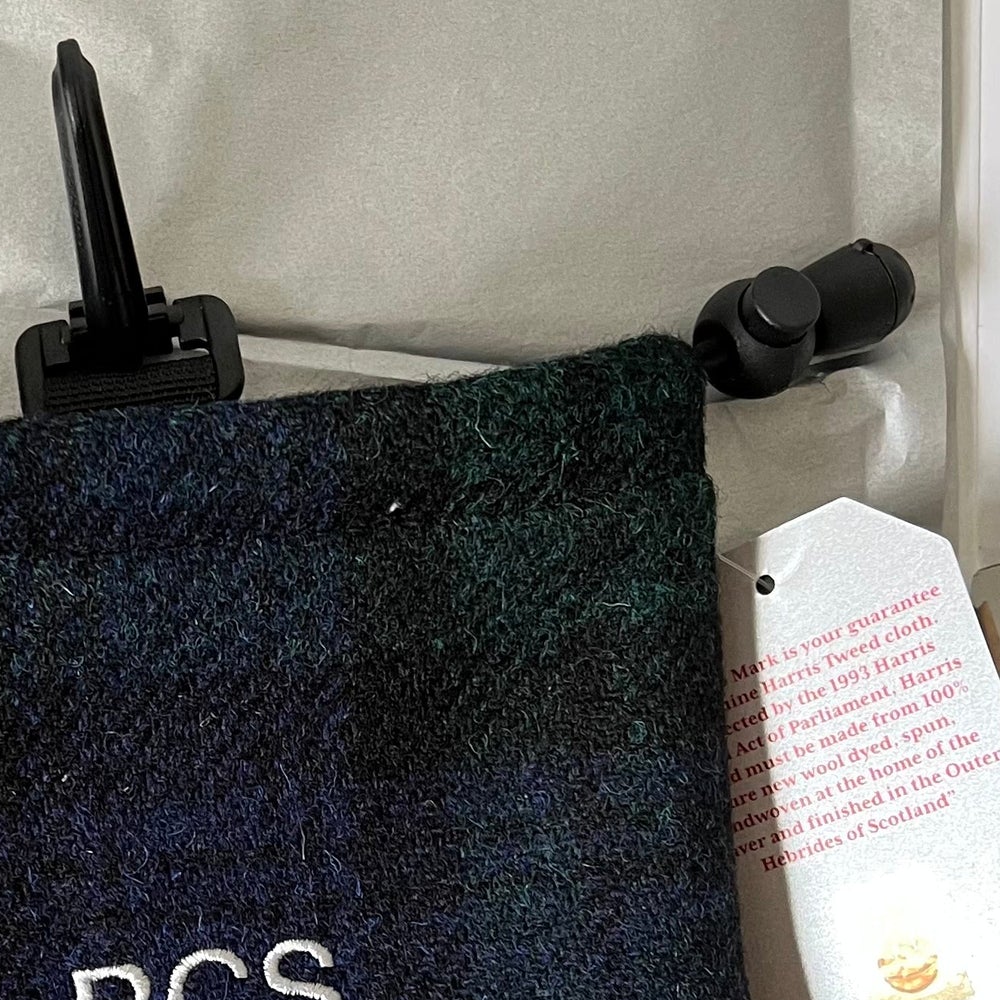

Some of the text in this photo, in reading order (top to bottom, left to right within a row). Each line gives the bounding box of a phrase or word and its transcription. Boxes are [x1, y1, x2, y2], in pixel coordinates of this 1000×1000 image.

[730, 584, 942, 683] Mark is your guarantee
[761, 662, 821, 695] Harris
[823, 636, 881, 668] Tweed
[884, 614, 939, 645] cloth.
[736, 655, 963, 757] Act of Parliament, Harris
[772, 699, 793, 718] by
[797, 686, 828, 707] the
[829, 664, 871, 693] 1993
[873, 638, 936, 675] Harris
[745, 749, 791, 779] must
[792, 739, 816, 759] be
[818, 721, 869, 749] made
[871, 700, 921, 729] from
[921, 679, 970, 708] 100%
[761, 774, 797, 797] new
[801, 755, 845, 781] wool
[847, 734, 899, 764] dyed,
[901, 715, 956, 744] spun,
[815, 786, 833, 801] at
[836, 774, 867, 795] the
[869, 752, 923, 782] home
[926, 740, 945, 760] of
[948, 729, 981, 751] the
[770, 821, 804, 844] and
[807, 789, 885, 831] finished
[887, 783, 909, 801] in
[910, 770, 943, 793] the
[945, 749, 1000, 779] Outer
[761, 832, 844, 873] Hebrides
[846, 822, 864, 843] of
